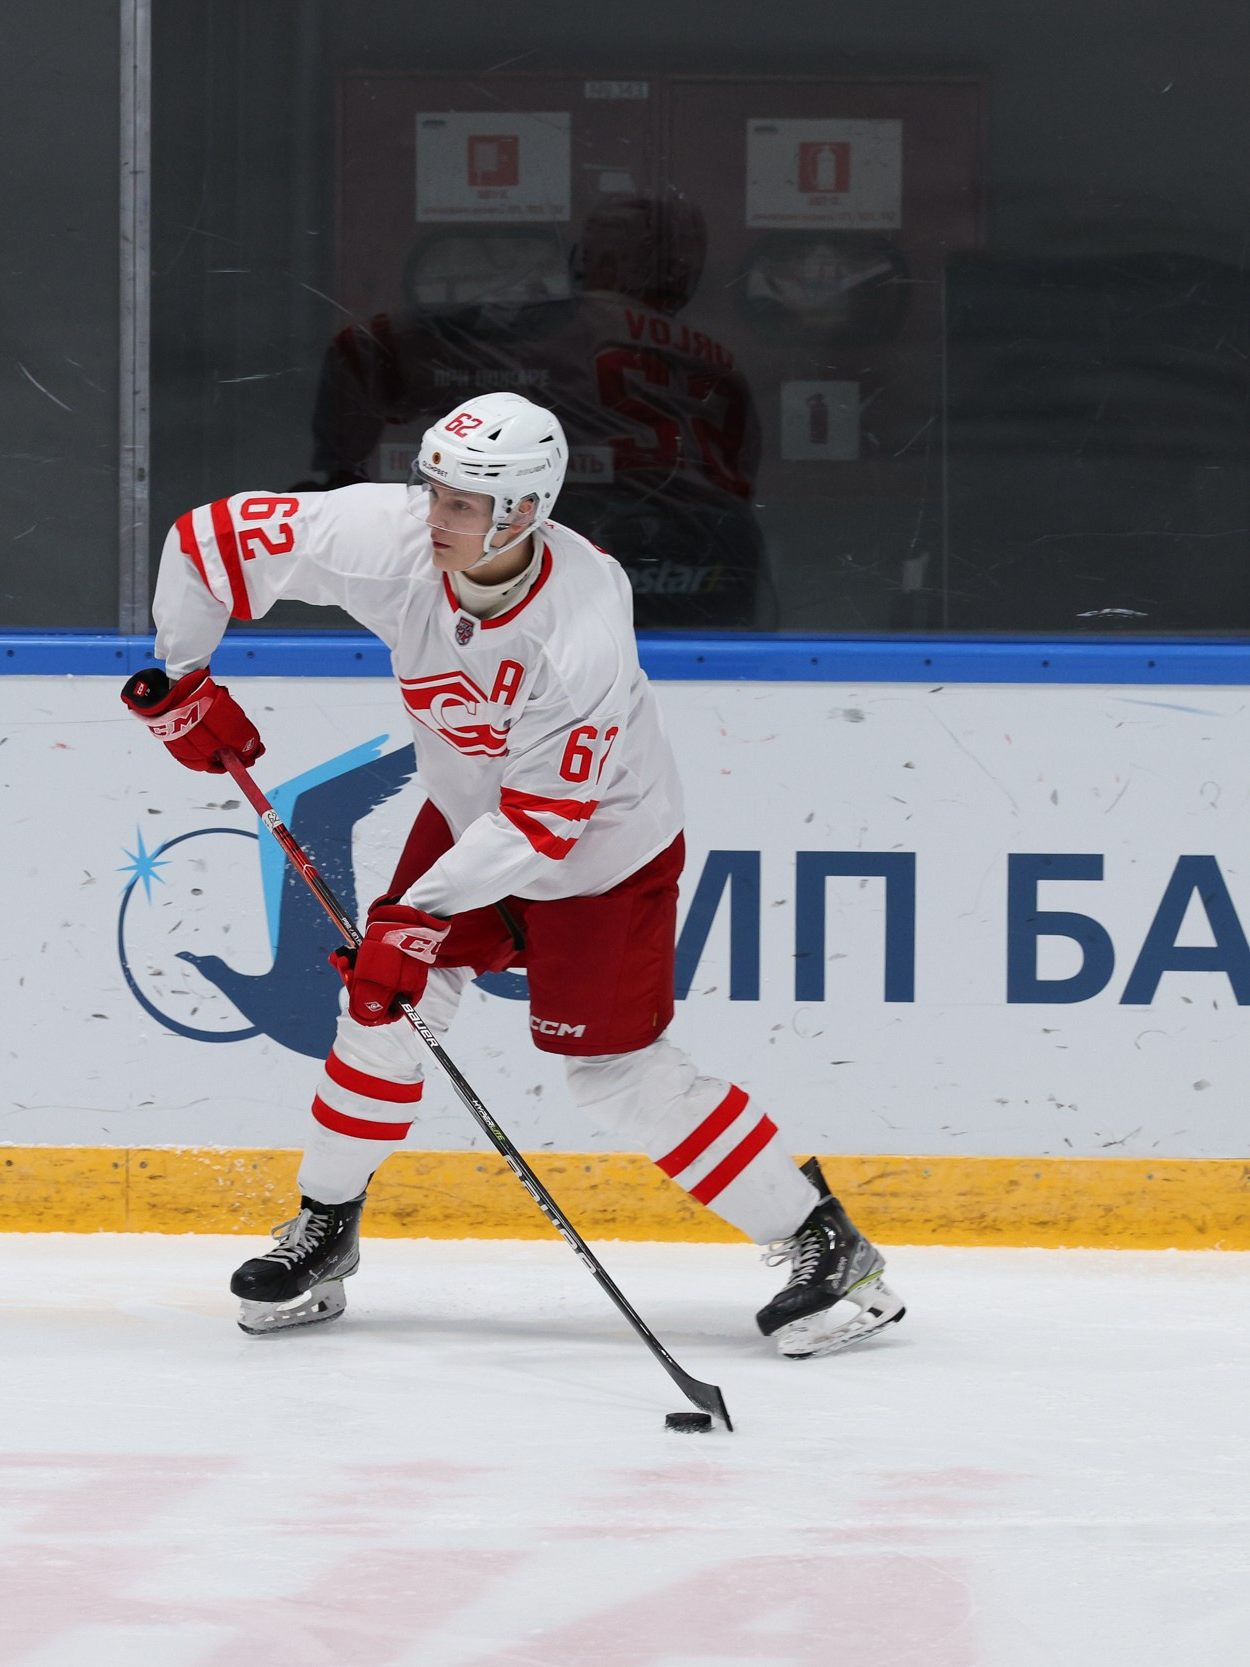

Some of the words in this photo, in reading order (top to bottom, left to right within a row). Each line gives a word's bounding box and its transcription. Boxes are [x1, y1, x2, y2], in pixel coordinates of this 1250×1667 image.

[445, 412, 483, 438] 62
[238, 497, 299, 561] 62
[489, 658, 525, 706] A
[1007, 853, 1250, 1006] БА
[530, 1015, 587, 1038] CCM
[472, 1100, 505, 1142] HYPERLITE
